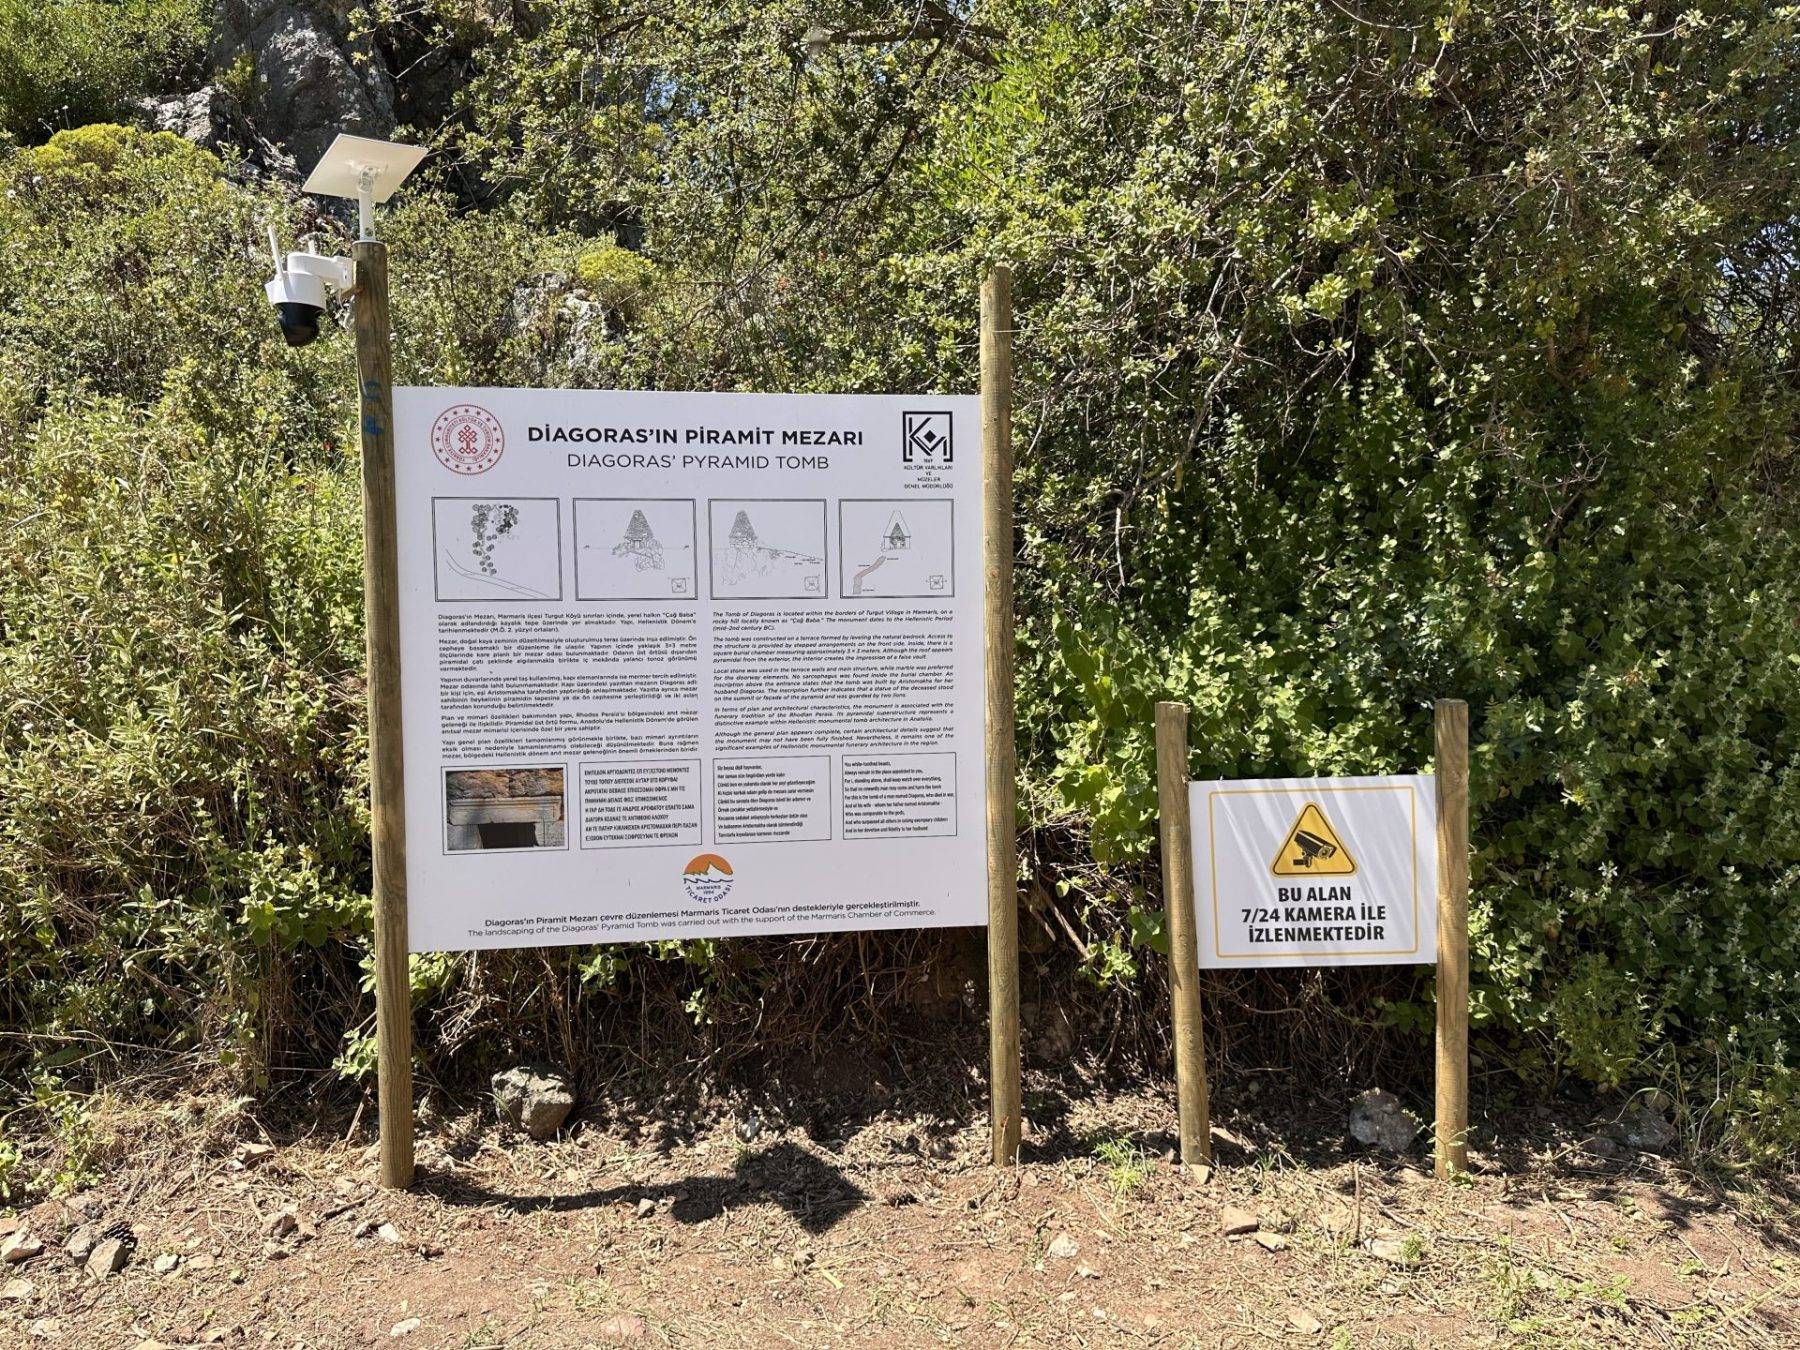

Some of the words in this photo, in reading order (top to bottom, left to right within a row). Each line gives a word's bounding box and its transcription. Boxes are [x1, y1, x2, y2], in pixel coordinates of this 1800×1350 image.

[527, 424, 677, 444] DİAGORAS'IN
[685, 425, 774, 445] PİRAMİT
[782, 430, 863, 446] MEZARI
[567, 453, 676, 469] DIAGORAS'
[682, 454, 770, 470] PYRAMID
[775, 456, 830, 470] TOMB
[1277, 887, 1302, 902] BU
[1305, 886, 1352, 902] ALAN
[484, 927, 535, 937] landscaping
[601, 922, 635, 932] Pyramid
[637, 921, 659, 929] Tomb
[678, 919, 705, 927] carried
[722, 917, 739, 925] with
[755, 915, 785, 925] support
[811, 912, 846, 921] Marmaris
[847, 911, 882, 919] Chamber
[485, 917, 534, 928] Diagoras'ın
[536, 916, 567, 924] Piramit
[569, 914, 598, 923] Mezarı
[600, 913, 624, 923] çevre
[625, 911, 679, 920] düzenlemesi
[680, 909, 719, 918] Marmaris
[722, 908, 750, 916] Ticaret
[752, 906, 791, 914] Odası'nın
[792, 903, 844, 914] destekleriyle
[1241, 907, 1281, 924] 7/24
[1284, 906, 1357, 923] KAMERA
[1360, 902, 1387, 921] İLE
[1248, 922, 1385, 944] İZLENMEKTEDİR
